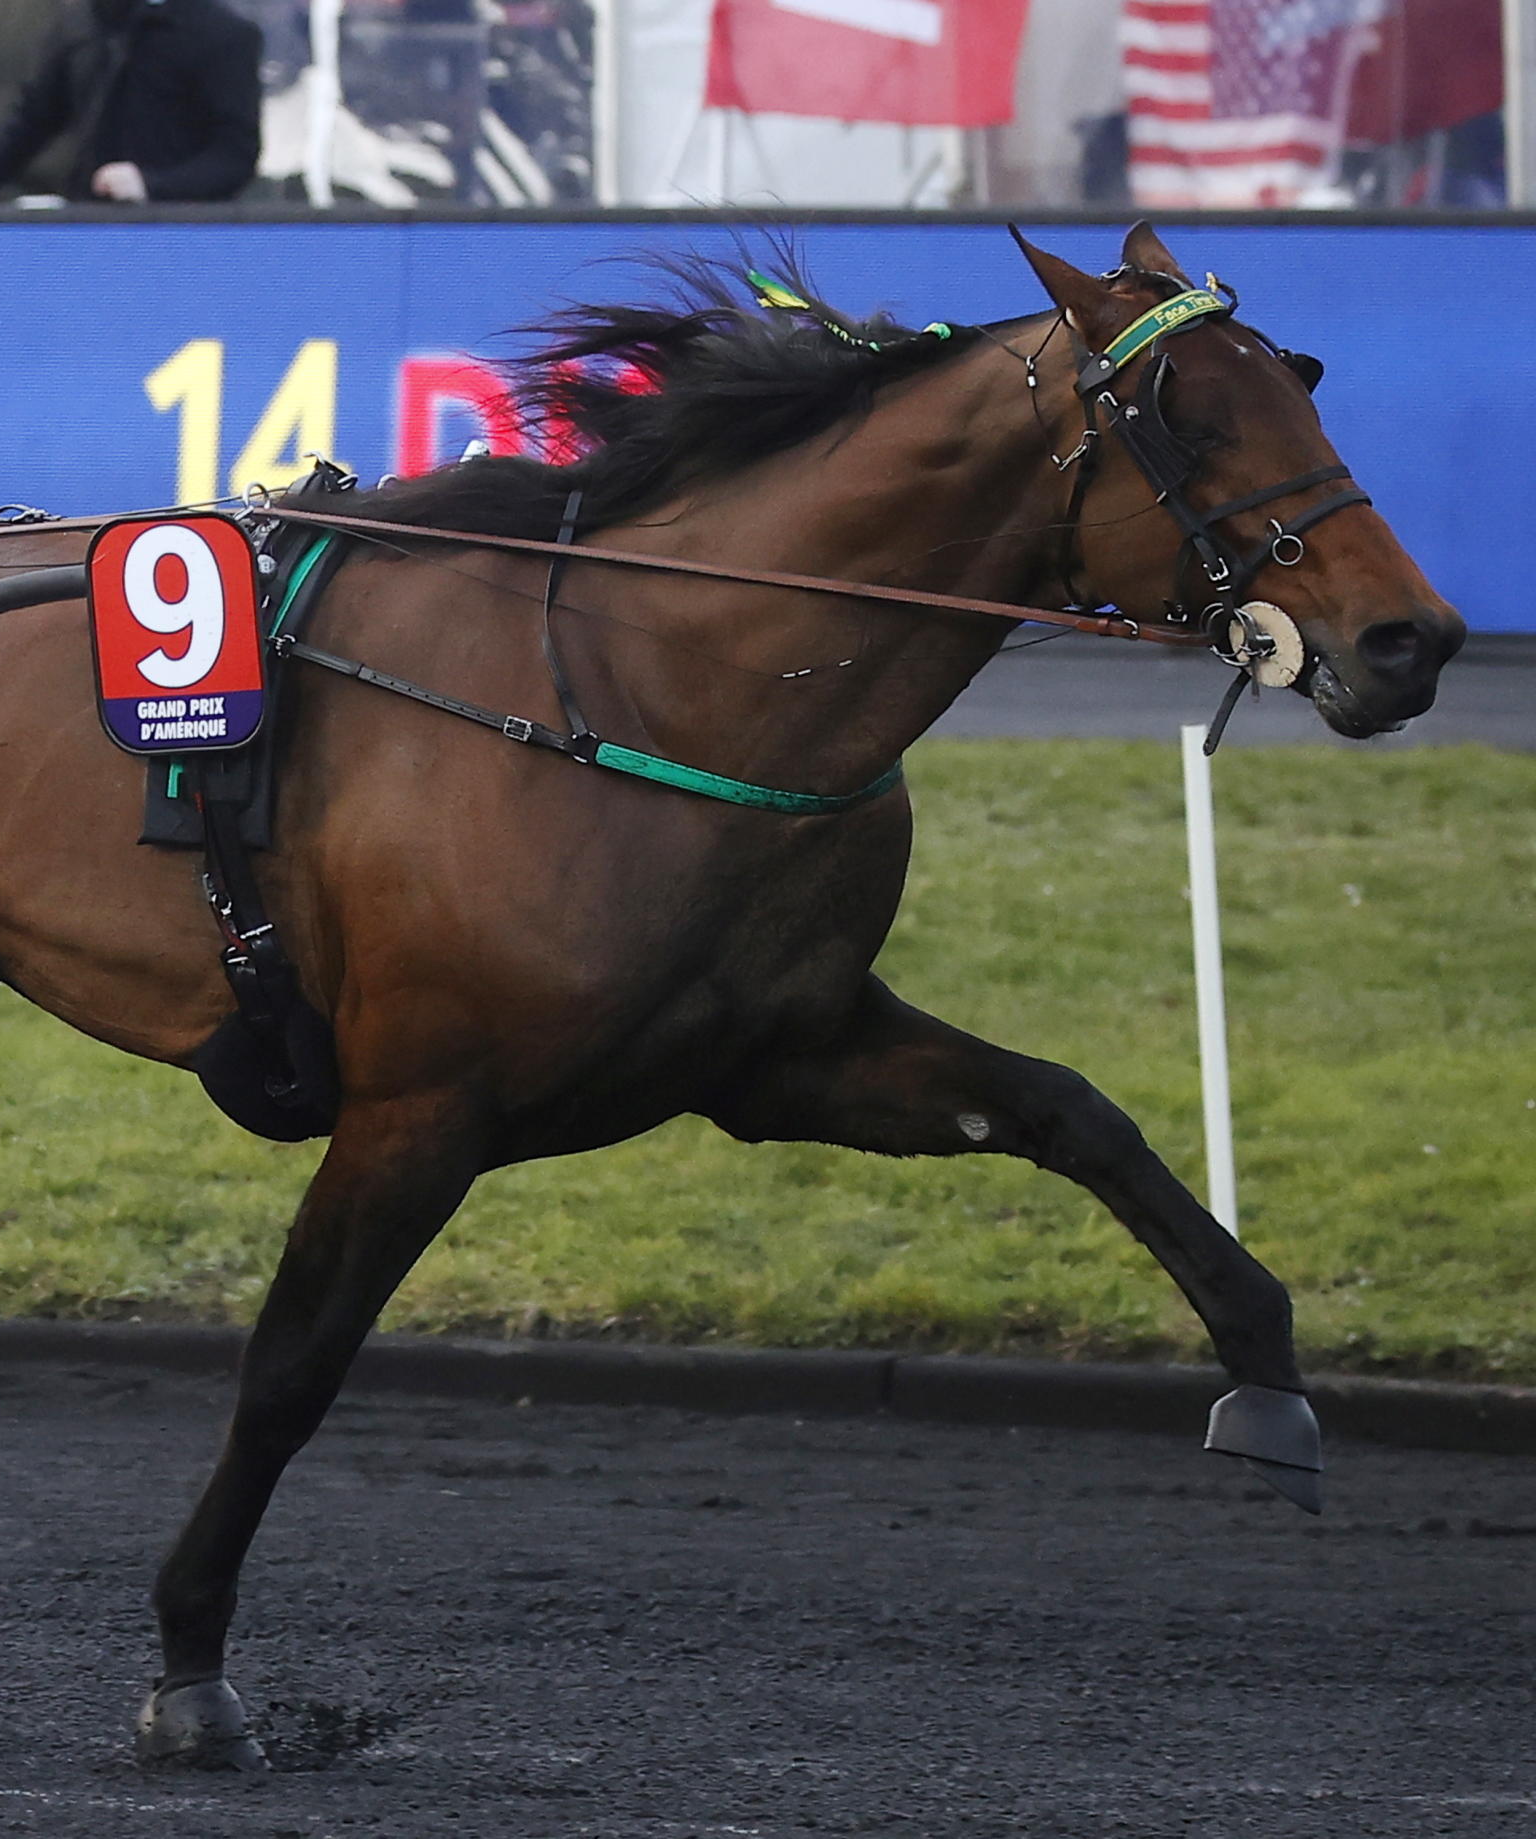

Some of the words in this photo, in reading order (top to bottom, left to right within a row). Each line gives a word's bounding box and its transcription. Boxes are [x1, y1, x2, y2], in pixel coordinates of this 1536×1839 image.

[144, 337, 354, 510] 14
[123, 523, 226, 689] 9
[137, 700, 187, 720] GRAND
[190, 697, 225, 717] PRIX
[140, 717, 227, 741] D'AMÉRIQUE
